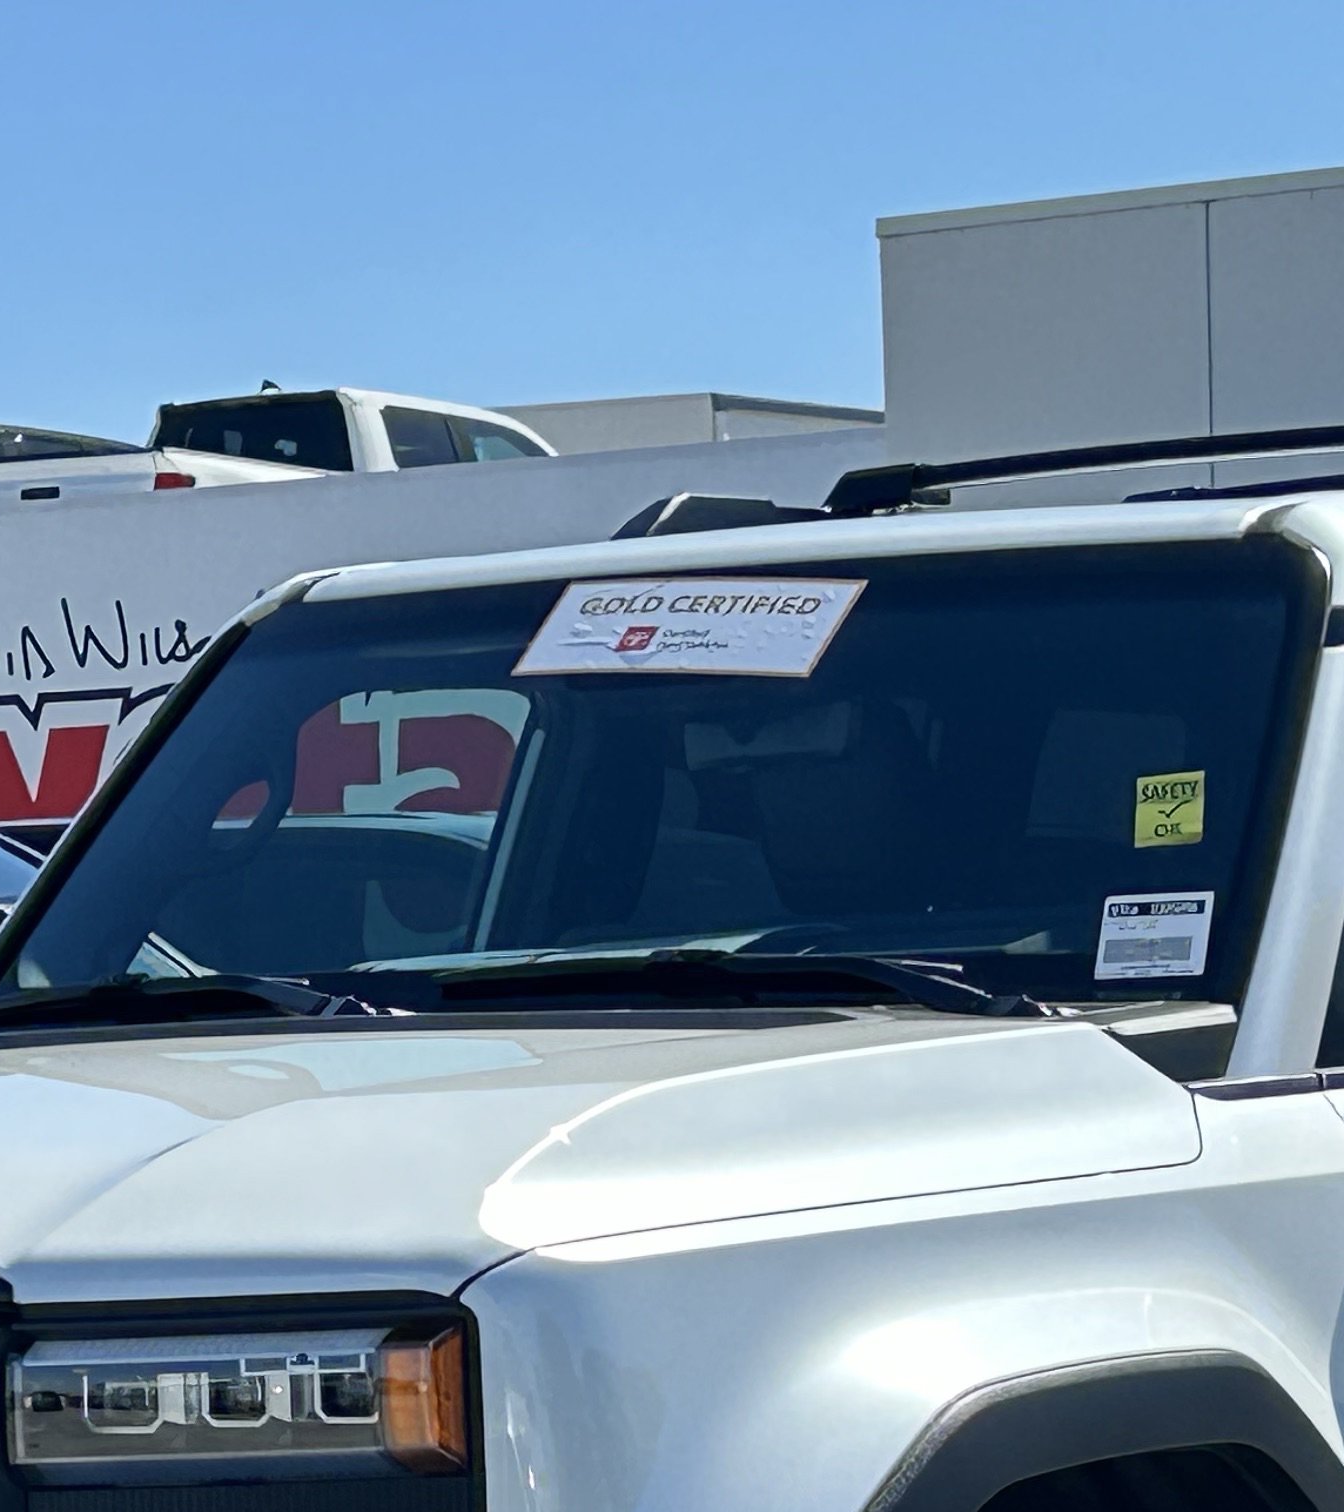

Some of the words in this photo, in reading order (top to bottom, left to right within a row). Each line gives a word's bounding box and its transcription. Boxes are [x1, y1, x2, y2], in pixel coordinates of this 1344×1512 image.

[580, 594, 662, 616] GOLD
[667, 594, 821, 616] CERTIFIED
[60, 597, 212, 669] WILS
[1140, 781, 1199, 803] SAFETY
